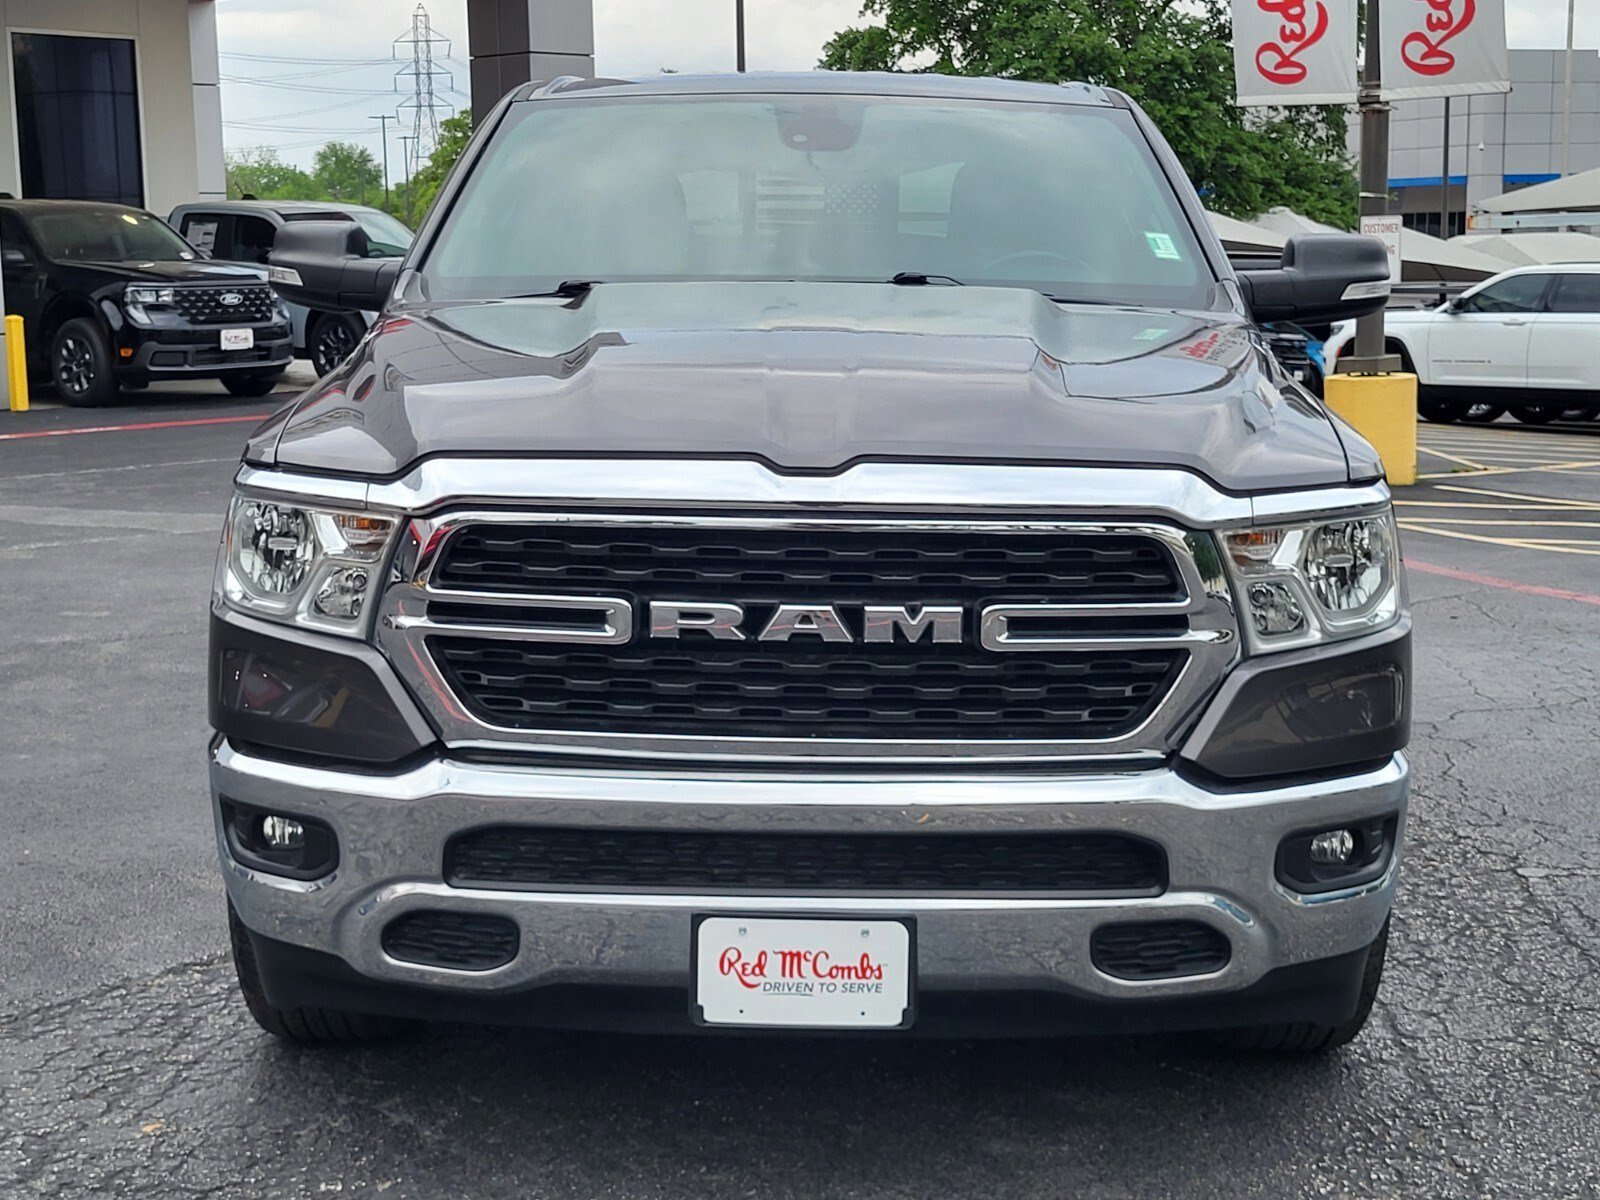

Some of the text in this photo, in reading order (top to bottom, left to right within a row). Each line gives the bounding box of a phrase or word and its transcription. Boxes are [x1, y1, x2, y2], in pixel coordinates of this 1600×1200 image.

[650, 600, 964, 643] RAM
[719, 946, 883, 988] Red McCombs
[763, 981, 883, 993] DRIVEN TO SERVE
